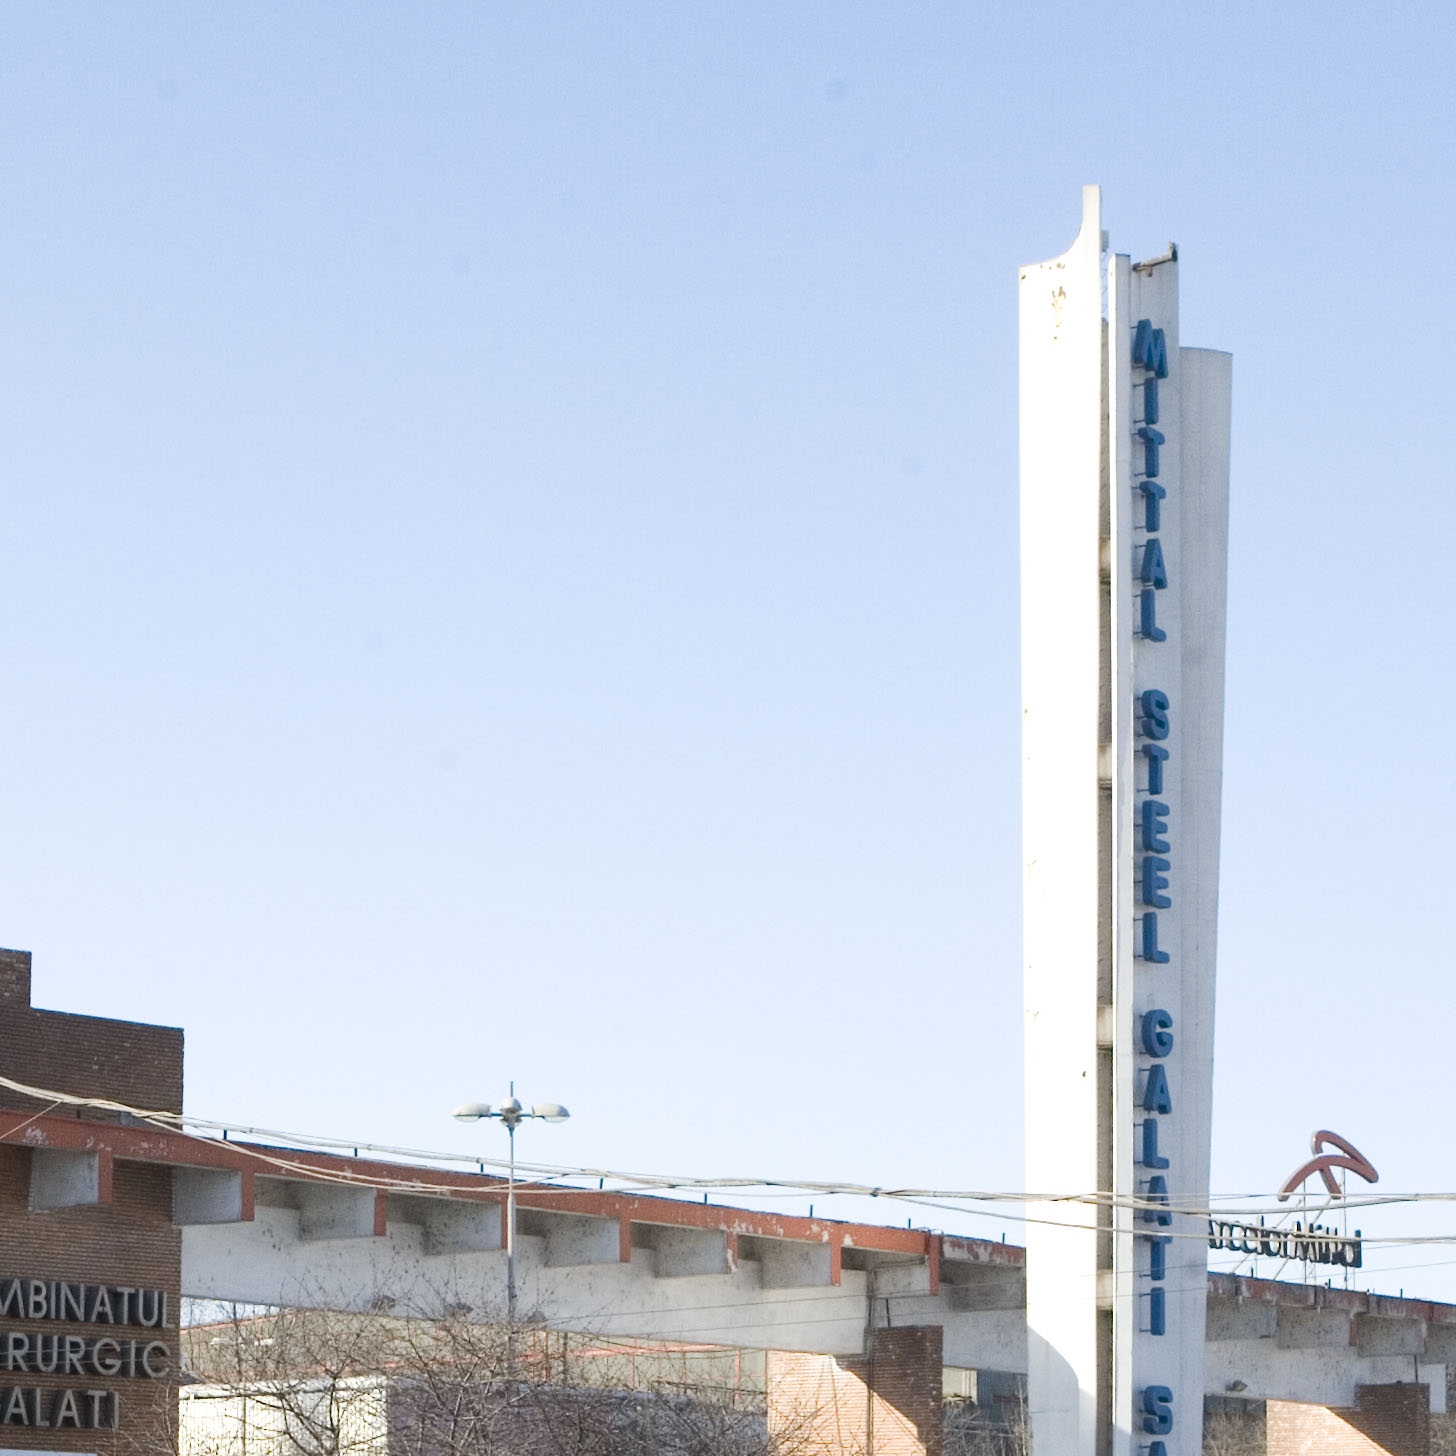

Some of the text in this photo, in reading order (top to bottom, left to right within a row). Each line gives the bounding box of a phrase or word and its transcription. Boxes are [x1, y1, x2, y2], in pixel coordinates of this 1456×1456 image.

[1133, 319, 1168, 642] MITTAL
[1142, 689, 1171, 964] STEEL
[1142, 1009, 1173, 1336] GALATI
